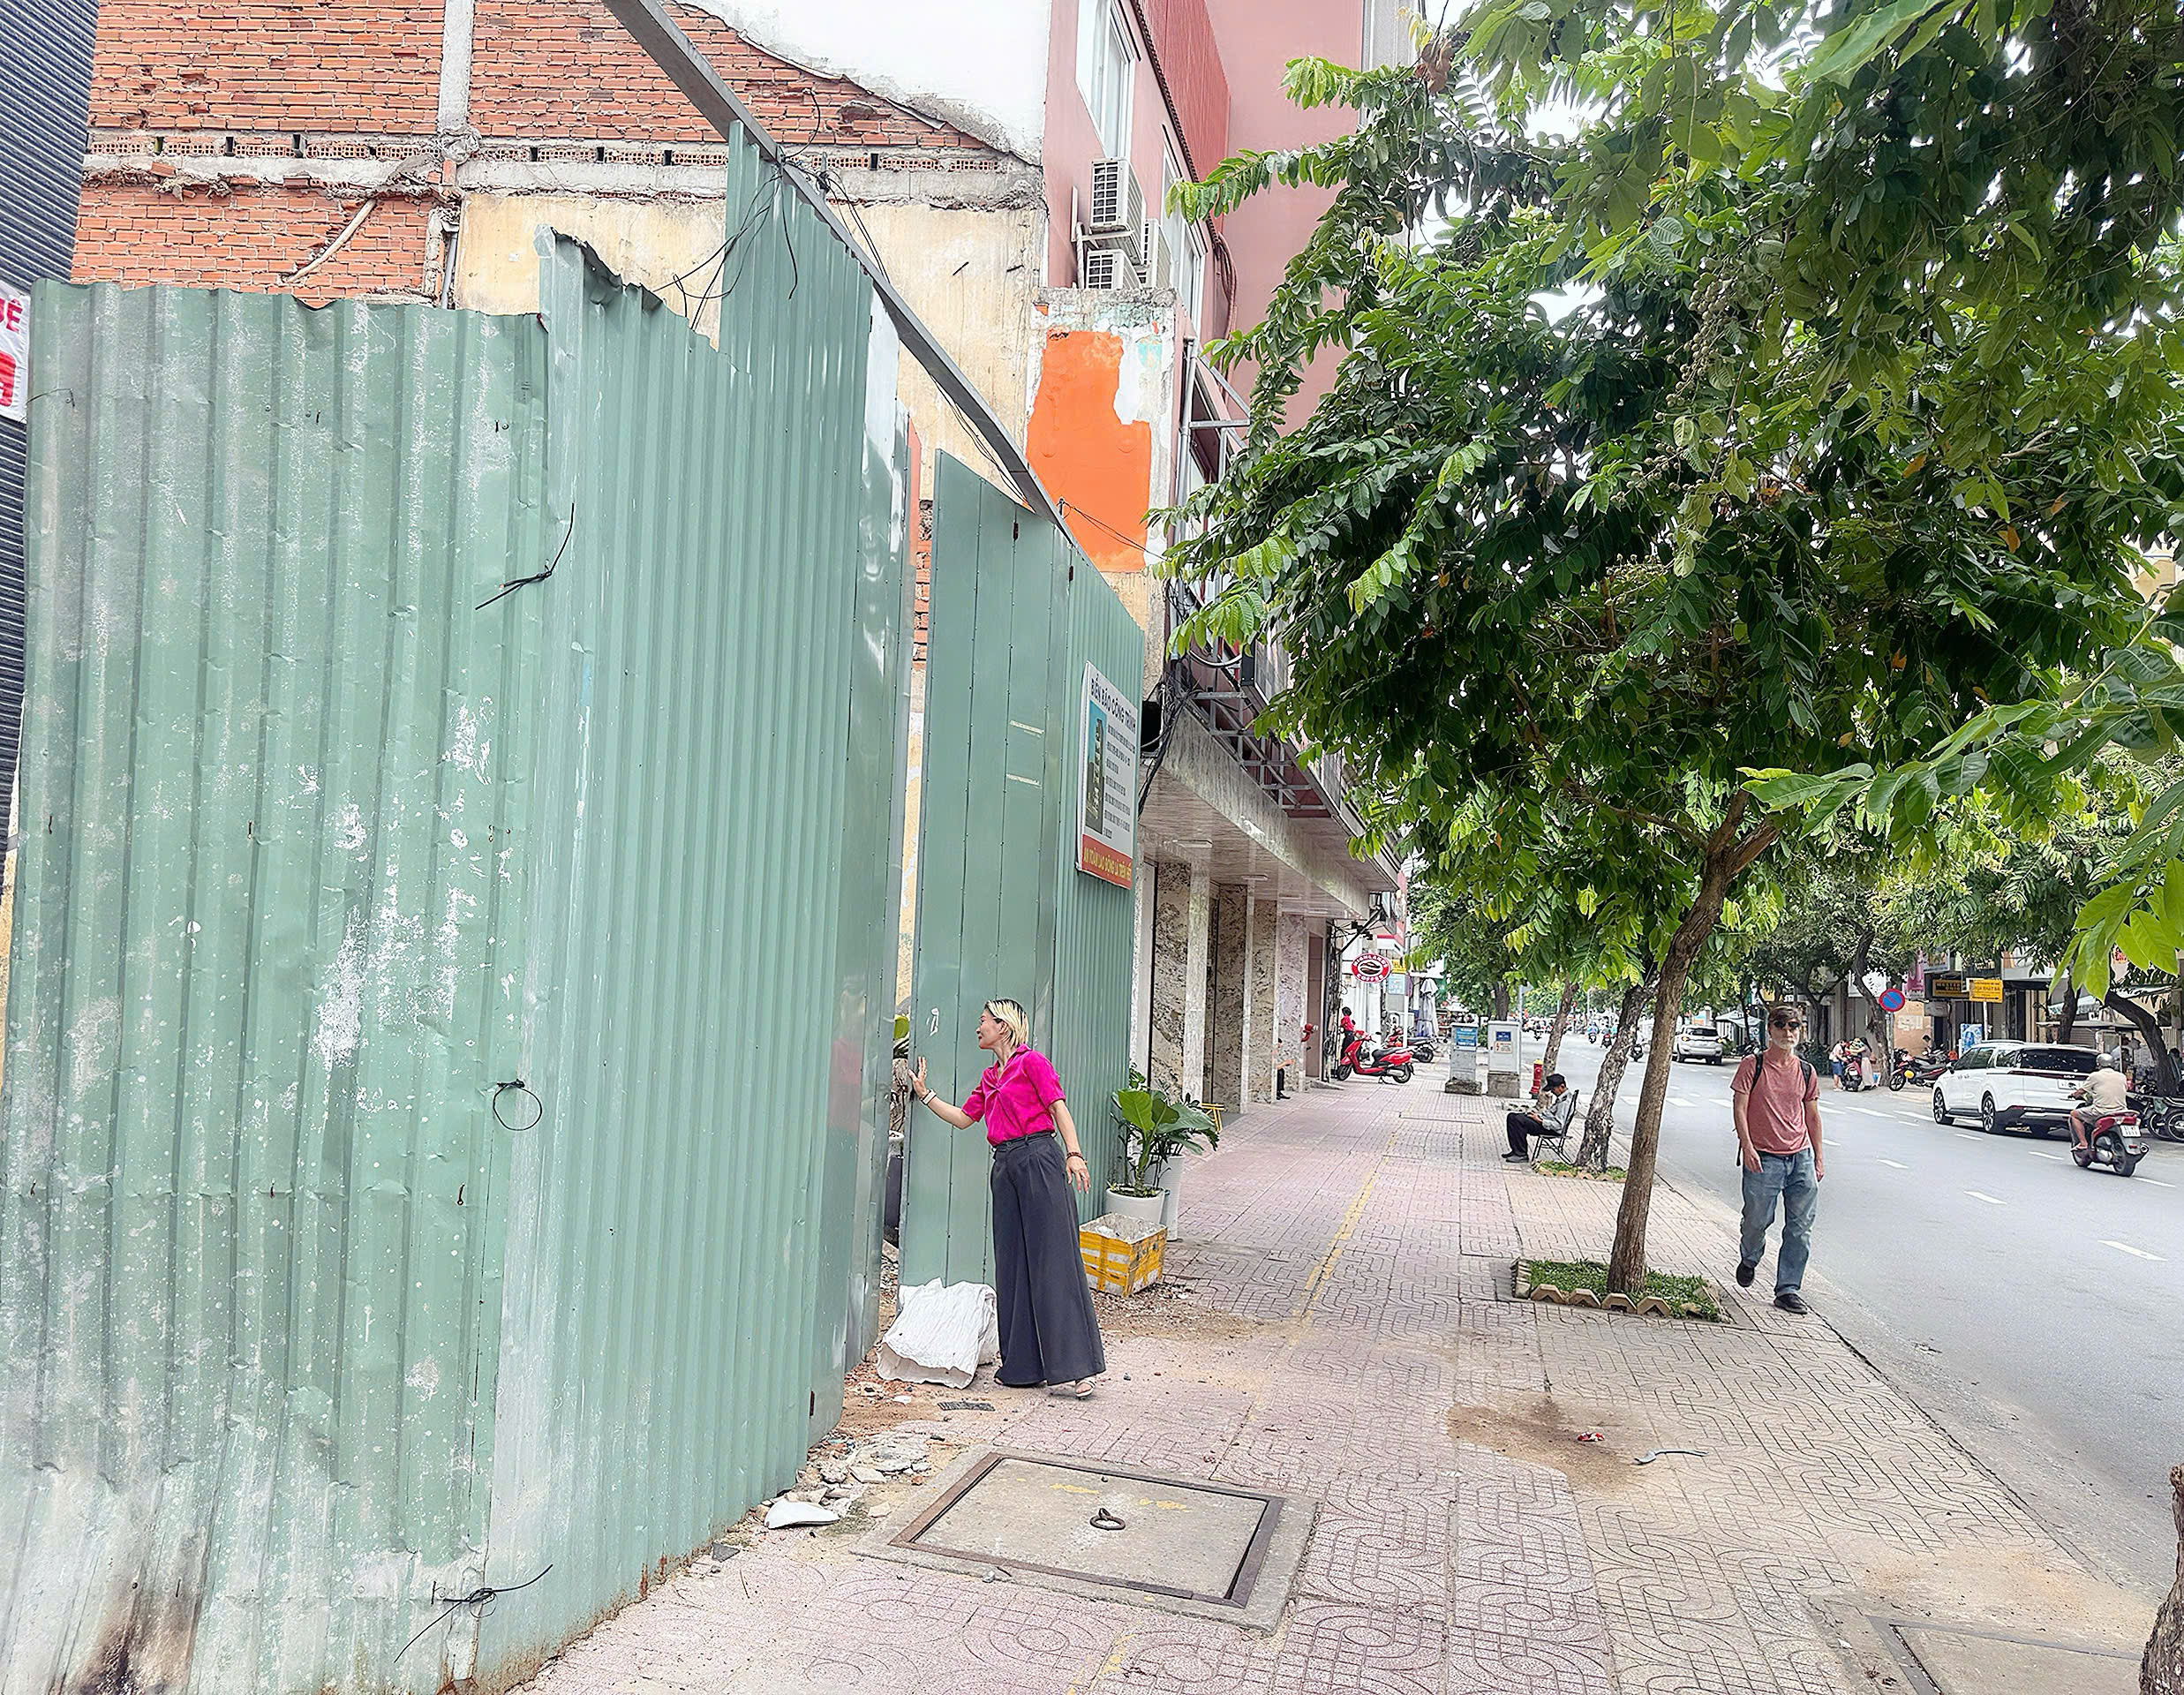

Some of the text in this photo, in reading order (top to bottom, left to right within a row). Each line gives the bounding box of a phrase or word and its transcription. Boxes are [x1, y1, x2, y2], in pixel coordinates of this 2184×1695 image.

[1090, 674, 1101, 703] BIỂN
[1101, 688, 1111, 712] BÁO
[1111, 697, 1124, 723] CÔNG
[1352, 954, 1388, 968] HIGHLANDS
